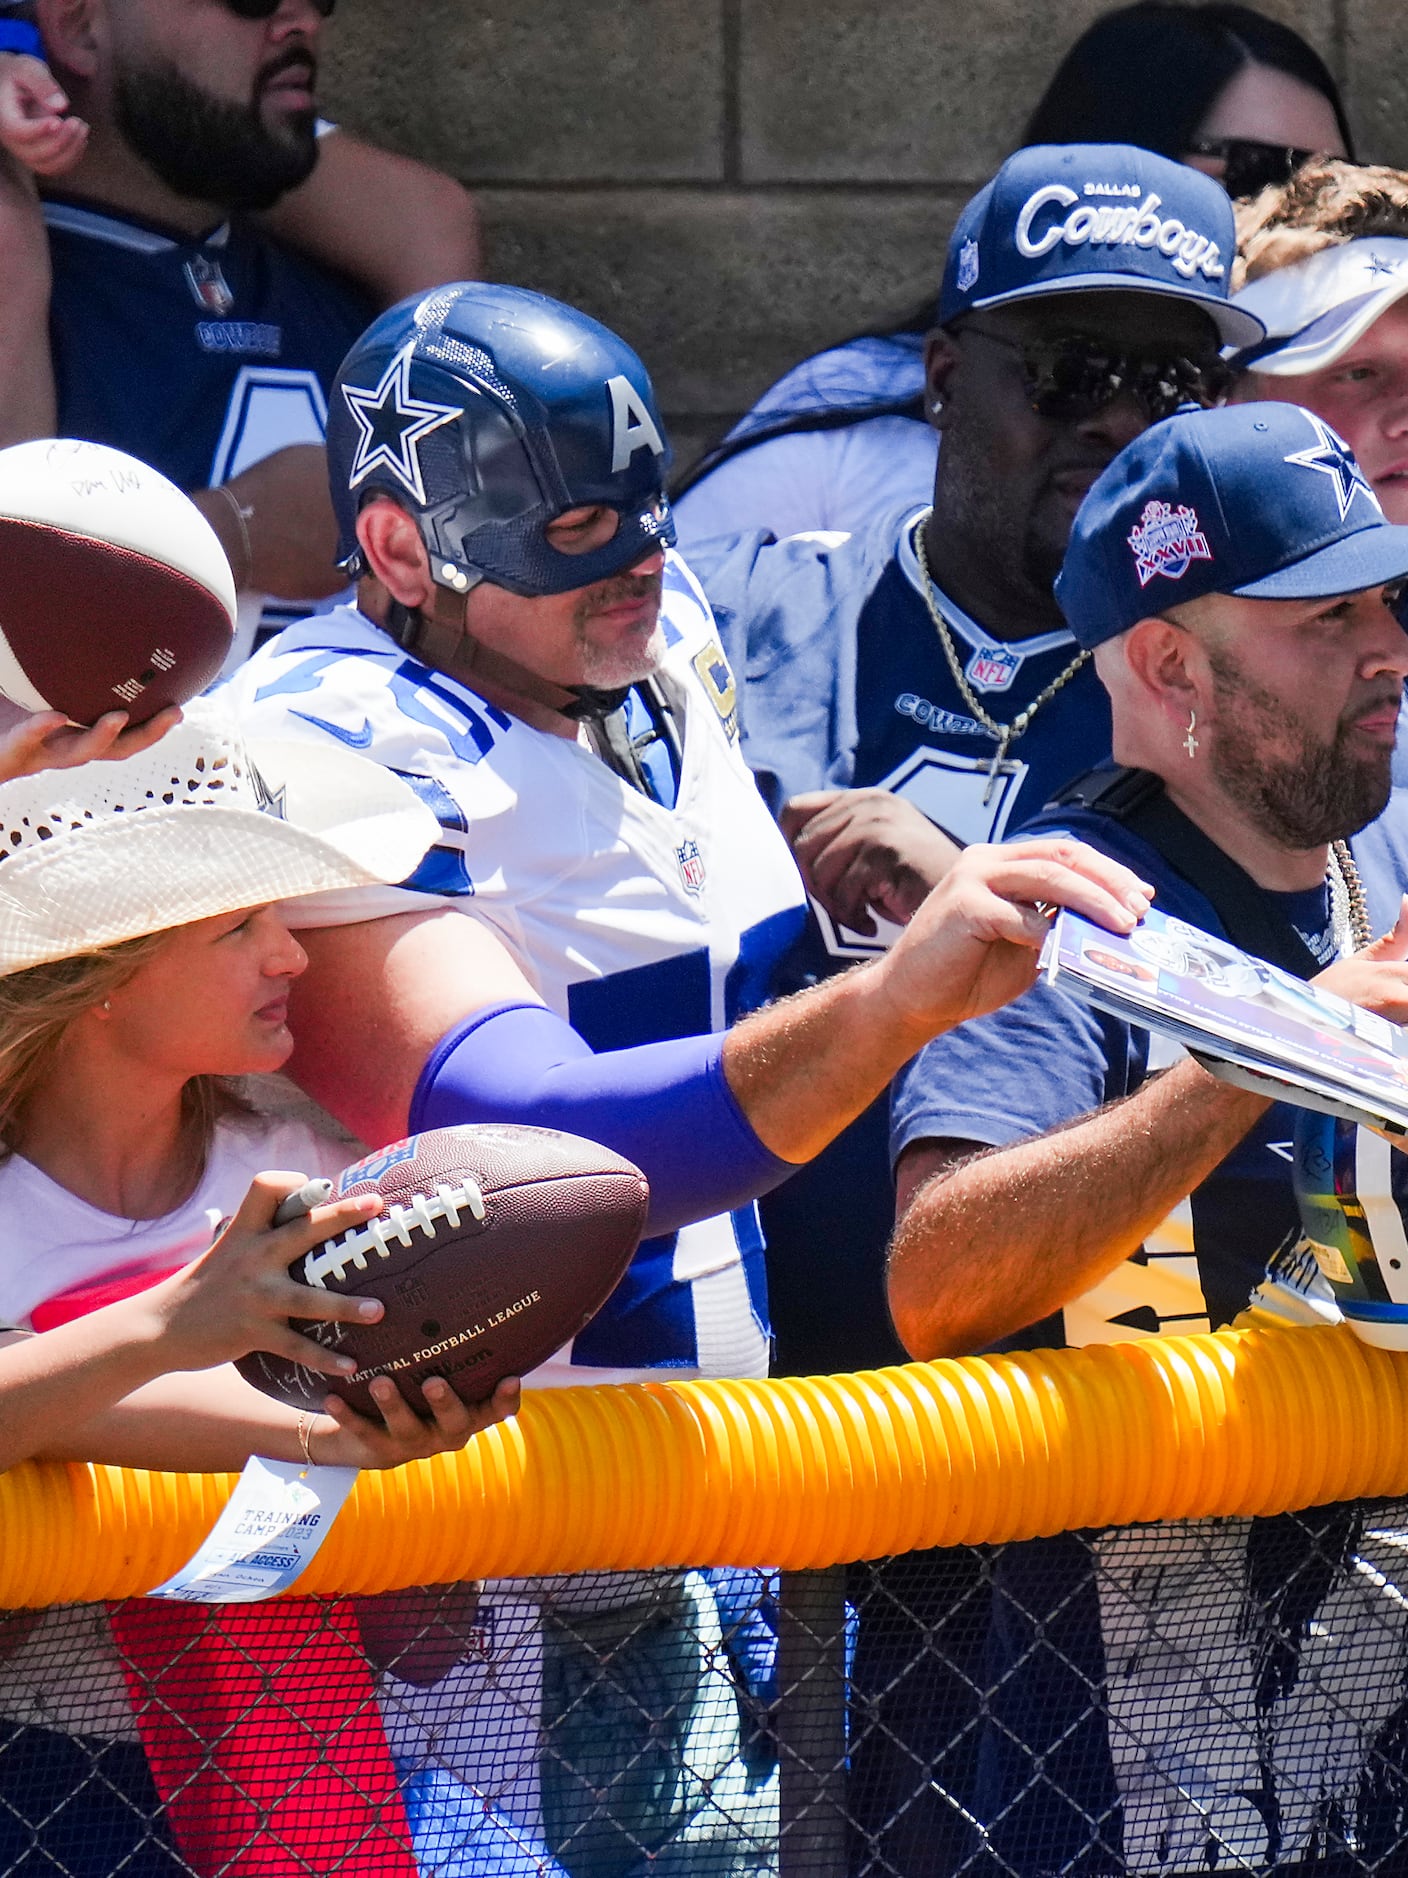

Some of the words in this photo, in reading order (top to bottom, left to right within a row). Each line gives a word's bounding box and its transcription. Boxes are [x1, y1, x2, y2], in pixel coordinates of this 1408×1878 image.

[1084, 183, 1142, 198] DALLAS
[1016, 184, 1225, 279] Cowboys
[607, 374, 664, 474] A
[973, 659, 1007, 684] NFL
[682, 858, 706, 887] NFL
[345, 1357, 411, 1385] NATIONAL
[412, 1323, 486, 1364] FOOTBALL
[487, 1289, 543, 1328] LEAGUE
[234, 1522, 276, 1537] CAMP
[244, 1509, 321, 1527] TRAINING
[249, 1554, 295, 1568] ACCESS
